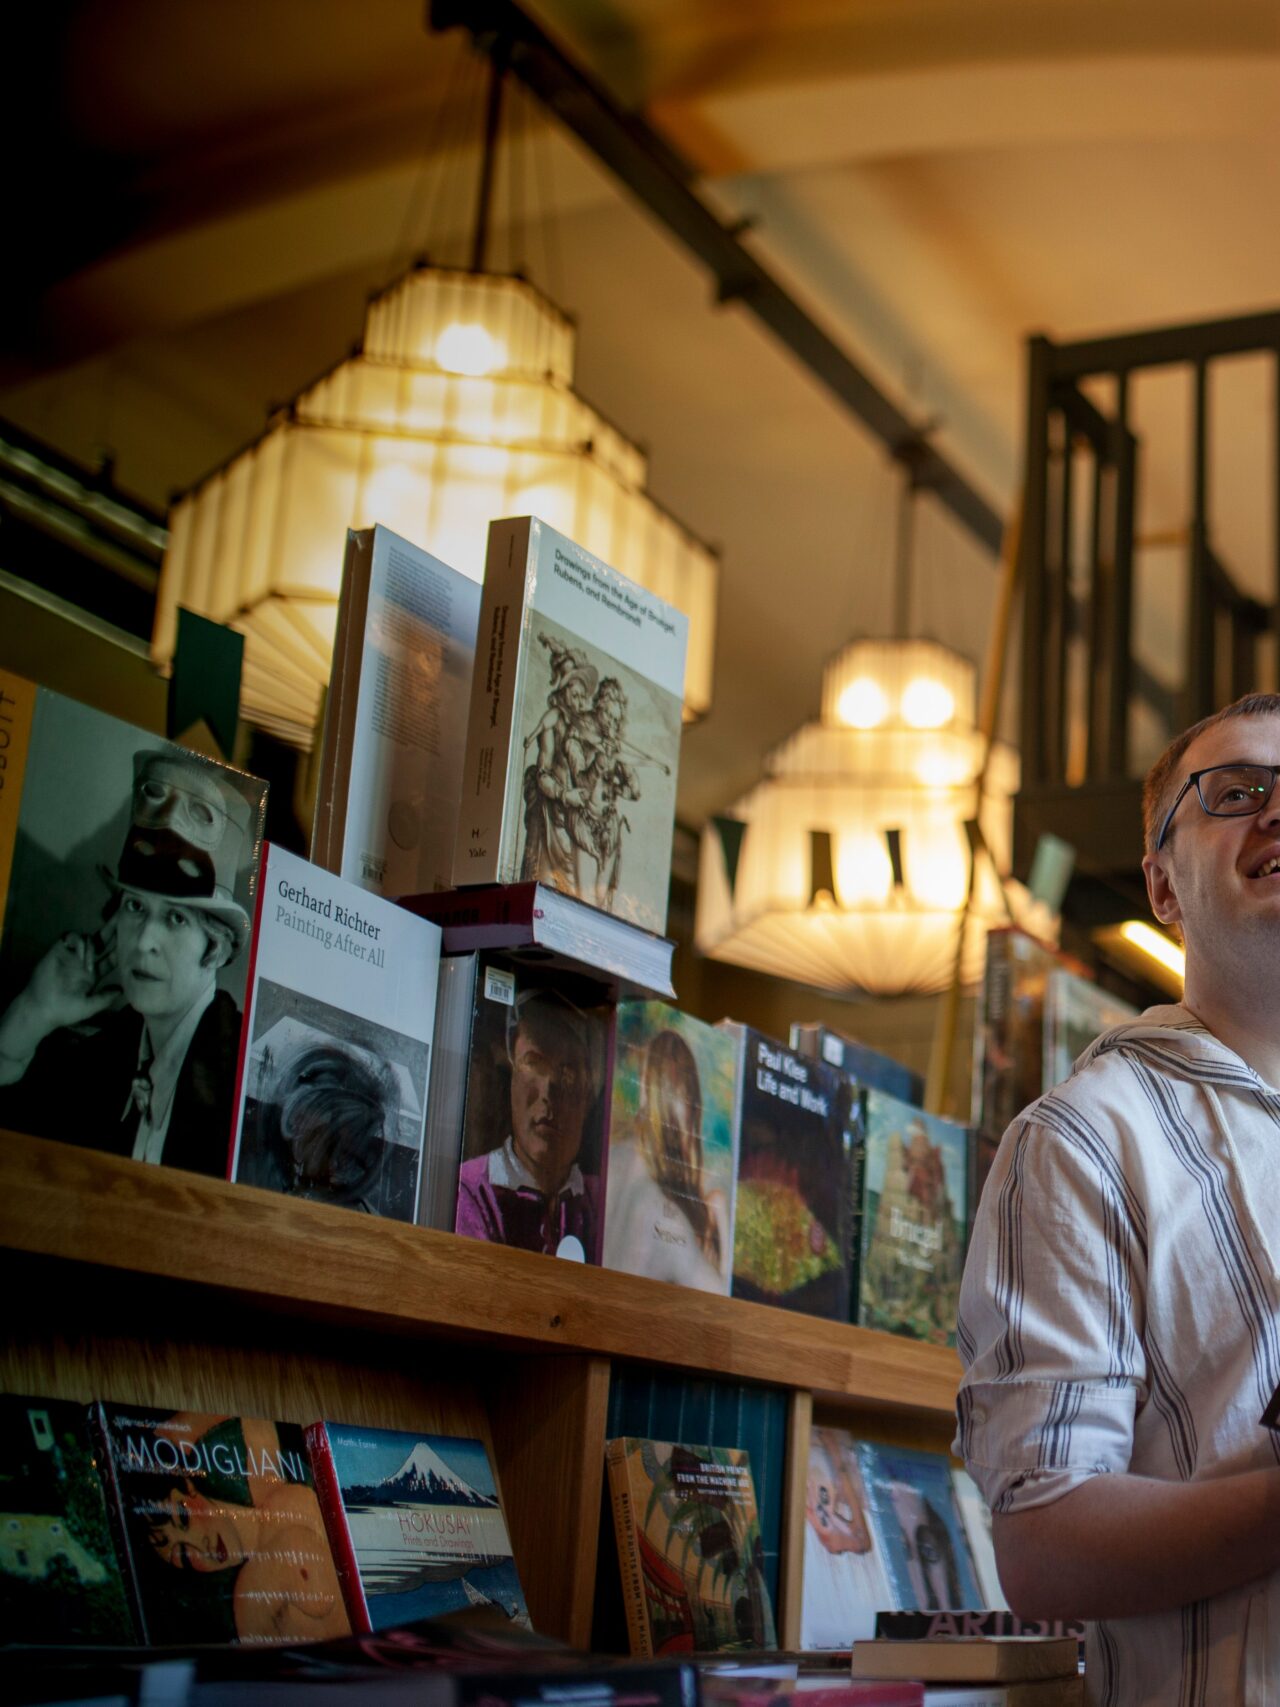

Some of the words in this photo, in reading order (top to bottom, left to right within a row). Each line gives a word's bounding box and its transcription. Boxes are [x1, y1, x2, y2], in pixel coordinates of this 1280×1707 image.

[553, 562, 585, 593] Rubens,
[585, 586, 600, 602] and
[601, 593, 642, 629] Rembrandt
[555, 547, 591, 581] Drawings
[592, 572, 610, 593] from
[611, 585, 623, 602] the
[624, 594, 639, 611] Age
[640, 605, 648, 616] of
[468, 848, 487, 858] Yale
[278, 880, 332, 918] Gerhard
[334, 905, 381, 940] Richter
[274, 904, 333, 950] Painting
[333, 933, 367, 960] After
[367, 947, 385, 968] All
[757, 1041, 781, 1072] Paul
[783, 1055, 808, 1083] Klee
[756, 1068, 778, 1097] Life
[777, 1080, 799, 1105] and
[126, 1434, 306, 1482] MODIGLIANI
[397, 1510, 472, 1536] HOKUSAI
[621, 1492, 632, 1533] BRITISH
[402, 1533, 424, 1546] Prints
[424, 1536, 440, 1548] and
[439, 1536, 474, 1549] Drawings
[627, 1534, 638, 1570] PRINTS
[631, 1572, 643, 1601] FROM
[635, 1602, 645, 1623] THE
